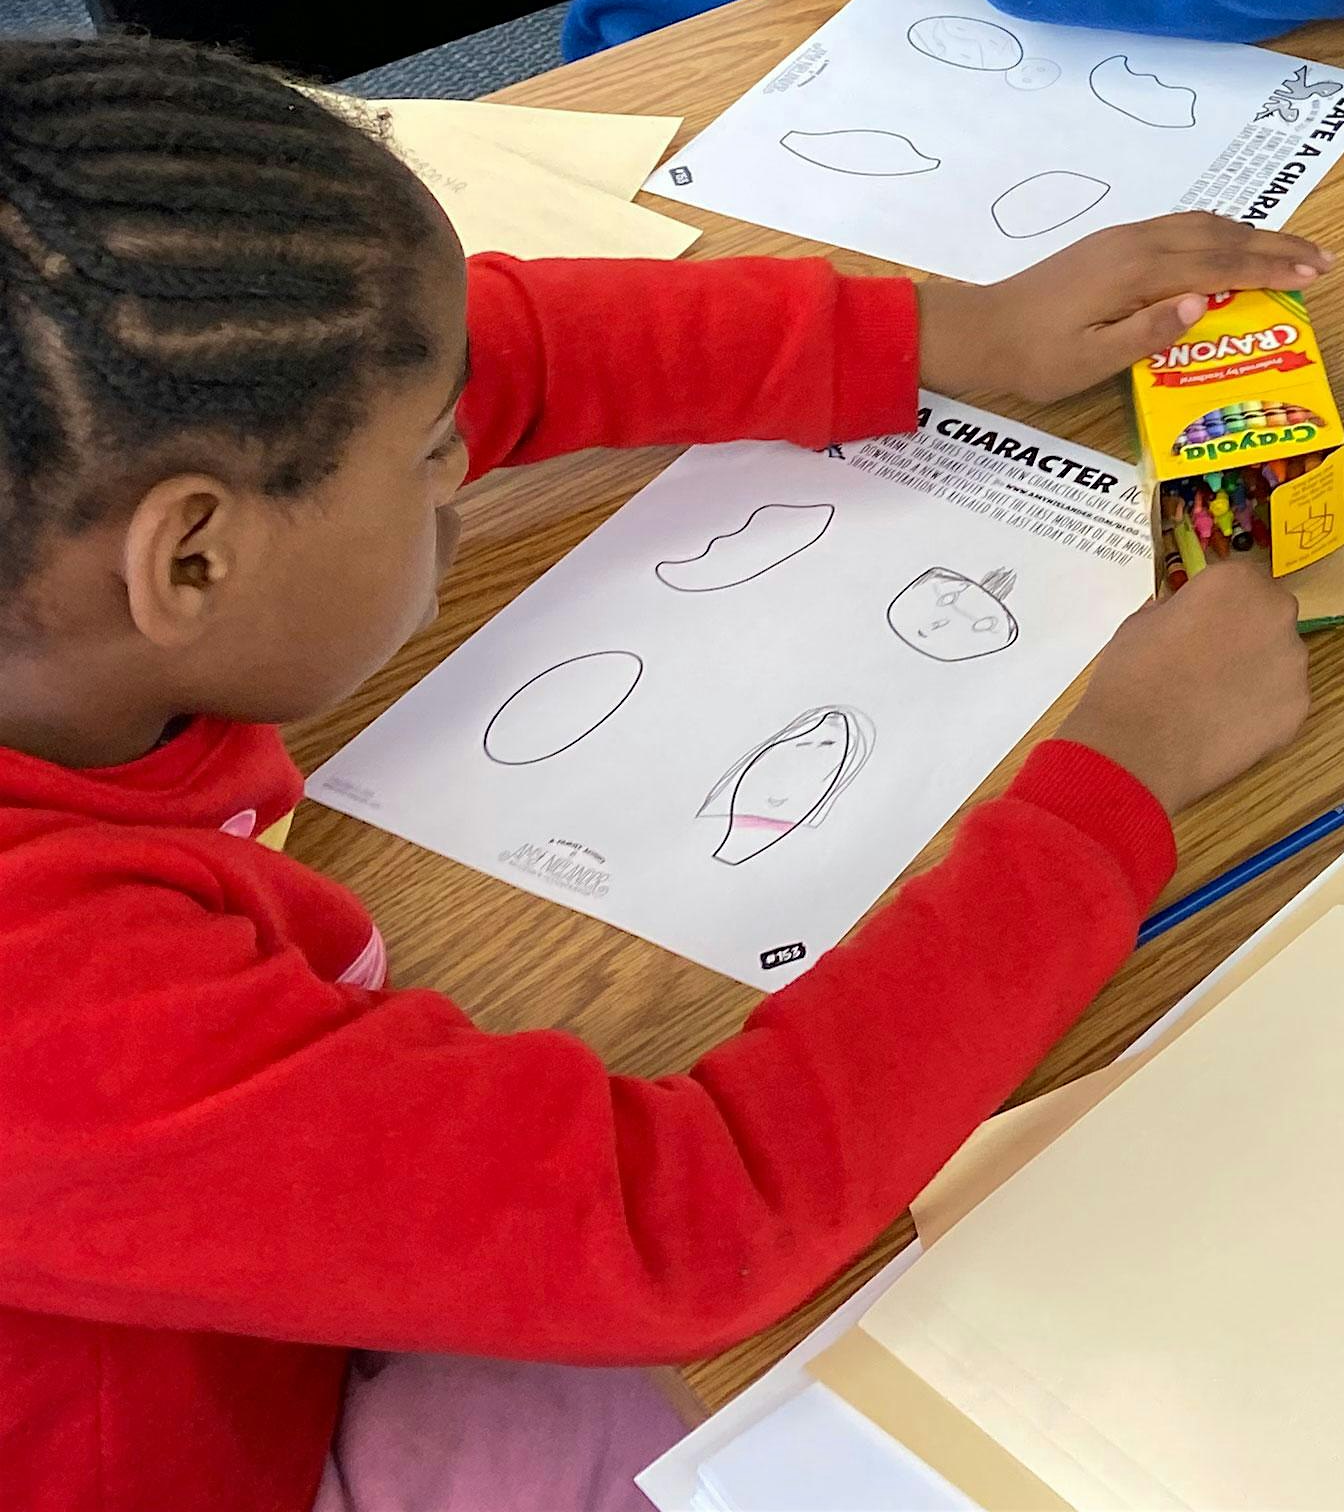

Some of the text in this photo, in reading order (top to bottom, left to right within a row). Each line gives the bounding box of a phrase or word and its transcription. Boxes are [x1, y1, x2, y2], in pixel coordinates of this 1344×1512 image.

[1295, 143, 1322, 157] A
[917, 407, 933, 428] A
[936, 417, 1118, 495] CHARACTER
[1184, 424, 1318, 462] Crayola
